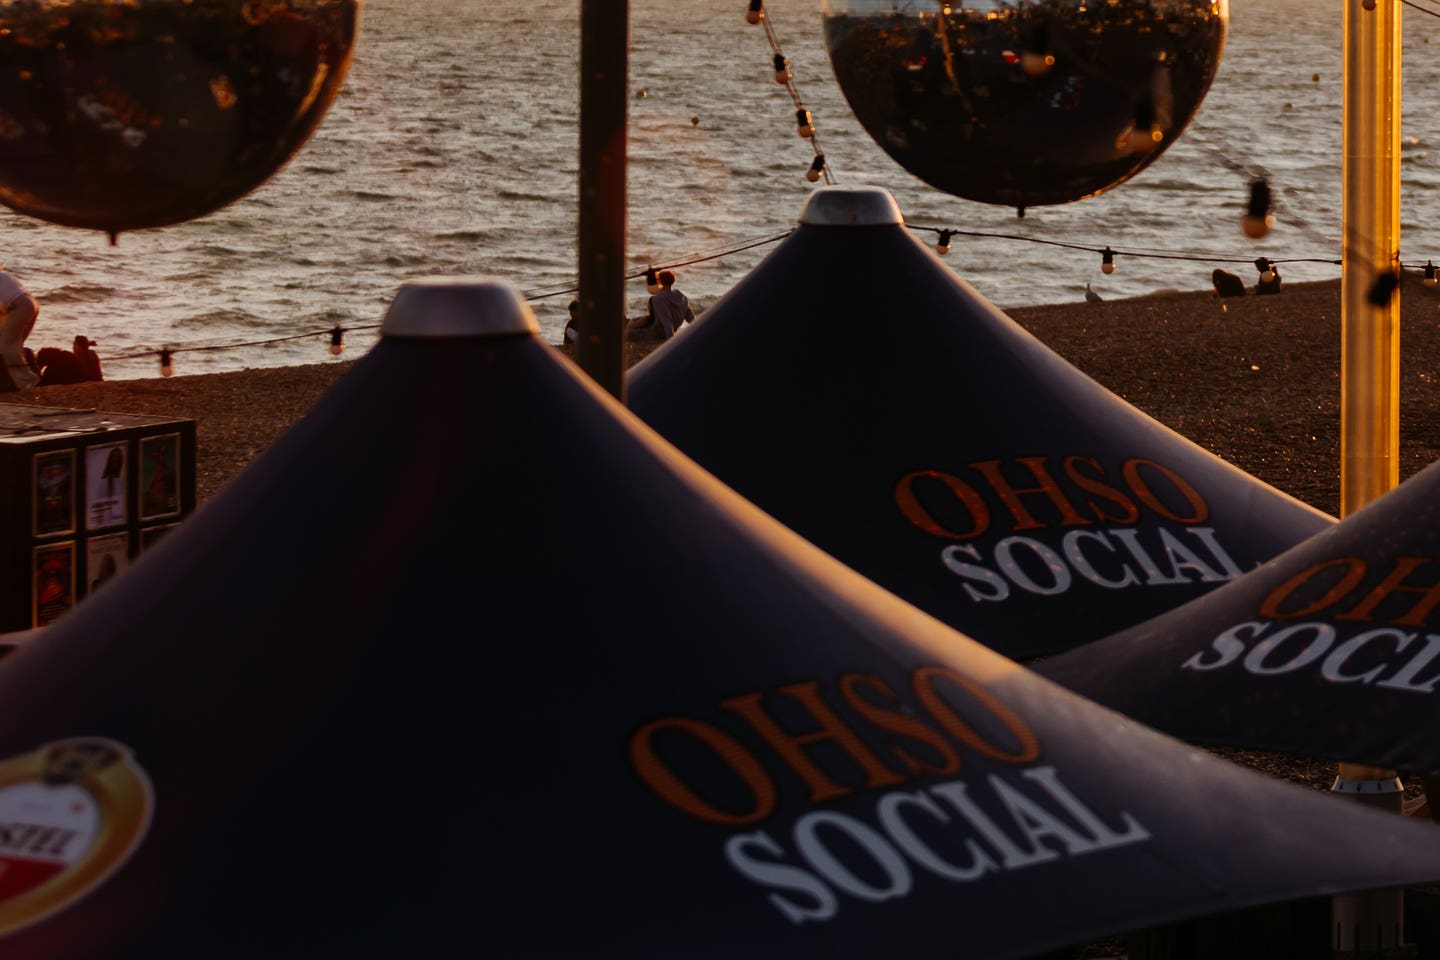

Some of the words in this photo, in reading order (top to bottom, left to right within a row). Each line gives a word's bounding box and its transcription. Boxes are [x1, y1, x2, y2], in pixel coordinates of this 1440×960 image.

[894, 456, 1209, 539] OHSO
[941, 527, 1262, 602] SOCIAL
[628, 666, 1041, 826] OHSO
[724, 766, 1153, 923] SOCIAL
